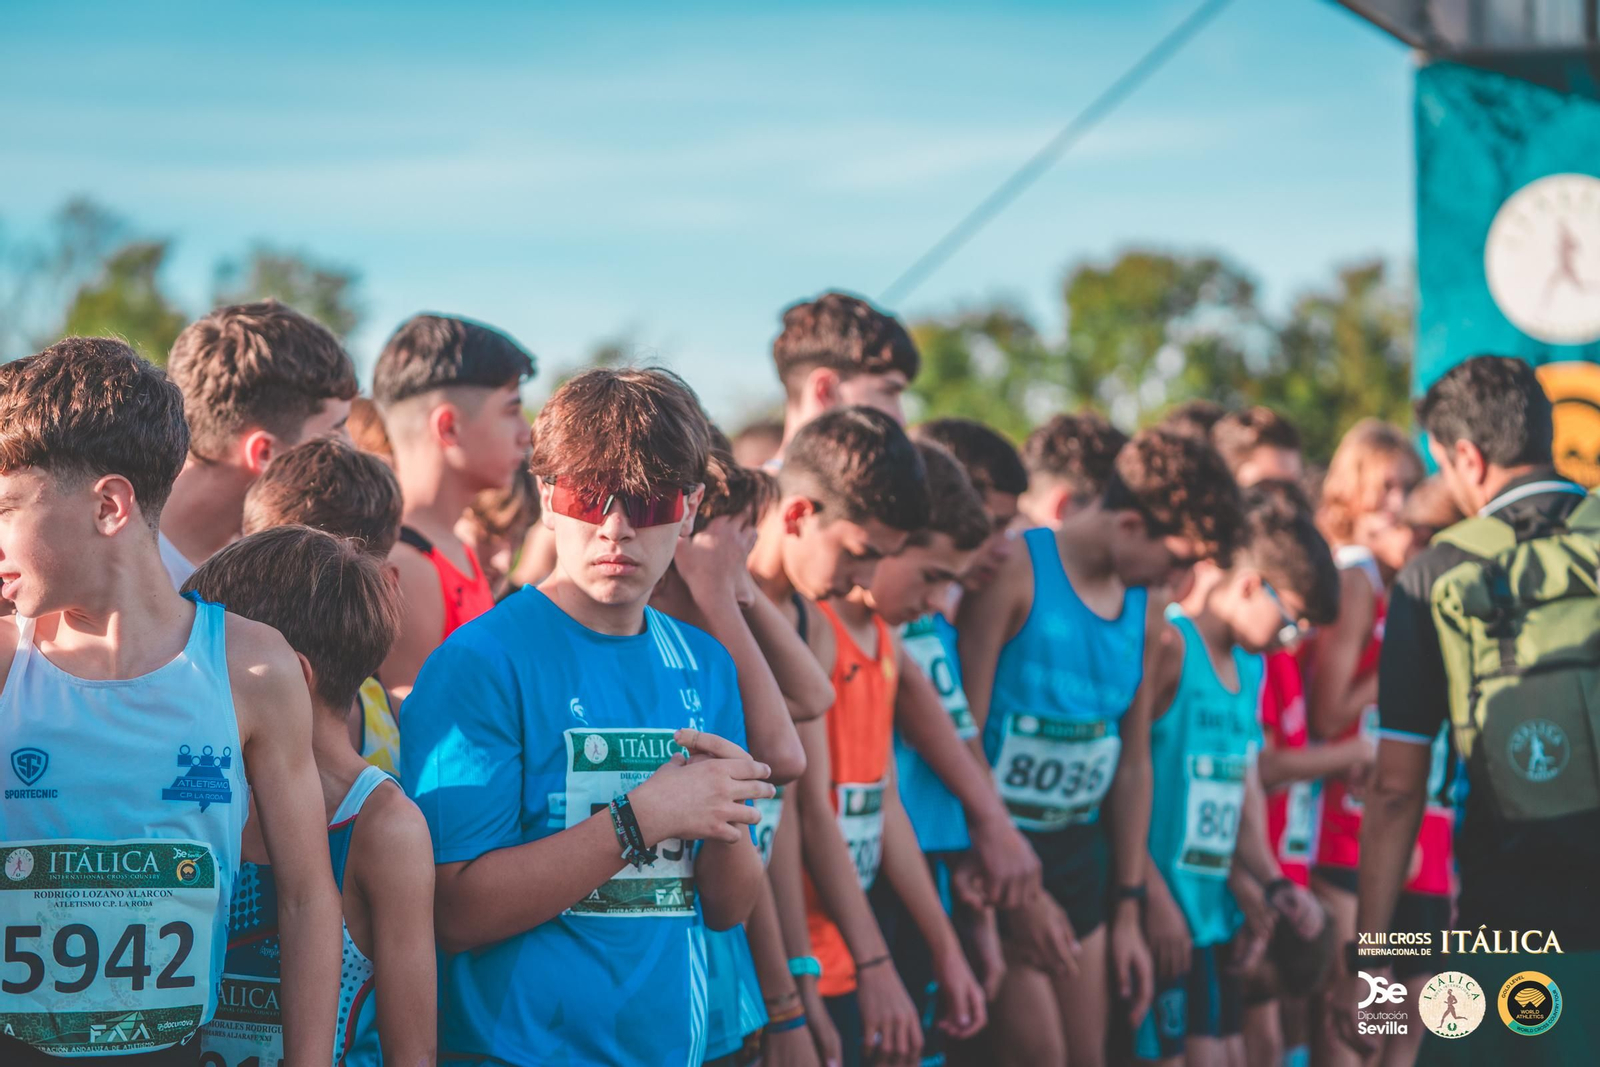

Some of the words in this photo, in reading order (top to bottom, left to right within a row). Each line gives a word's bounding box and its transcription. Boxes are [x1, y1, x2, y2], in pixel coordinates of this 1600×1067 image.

[177, 778, 229, 789] ATLETISMO
[4, 789, 59, 800] SPORTECNIC
[194, 792, 205, 800] LA
[206, 793, 224, 801] RODA
[49, 846, 160, 873] ITÁLICA
[33, 890, 80, 899] RODRIGO
[82, 889, 125, 899] LOZANO
[126, 889, 174, 898] ALARCON
[53, 900, 101, 908] ATLETISMO
[102, 900, 117, 908] C.P.
[2, 920, 196, 995] 5942
[218, 980, 280, 1010] ÁLICA
[245, 1024, 283, 1035] RODRIGU
[258, 1033, 272, 1042] XXI
